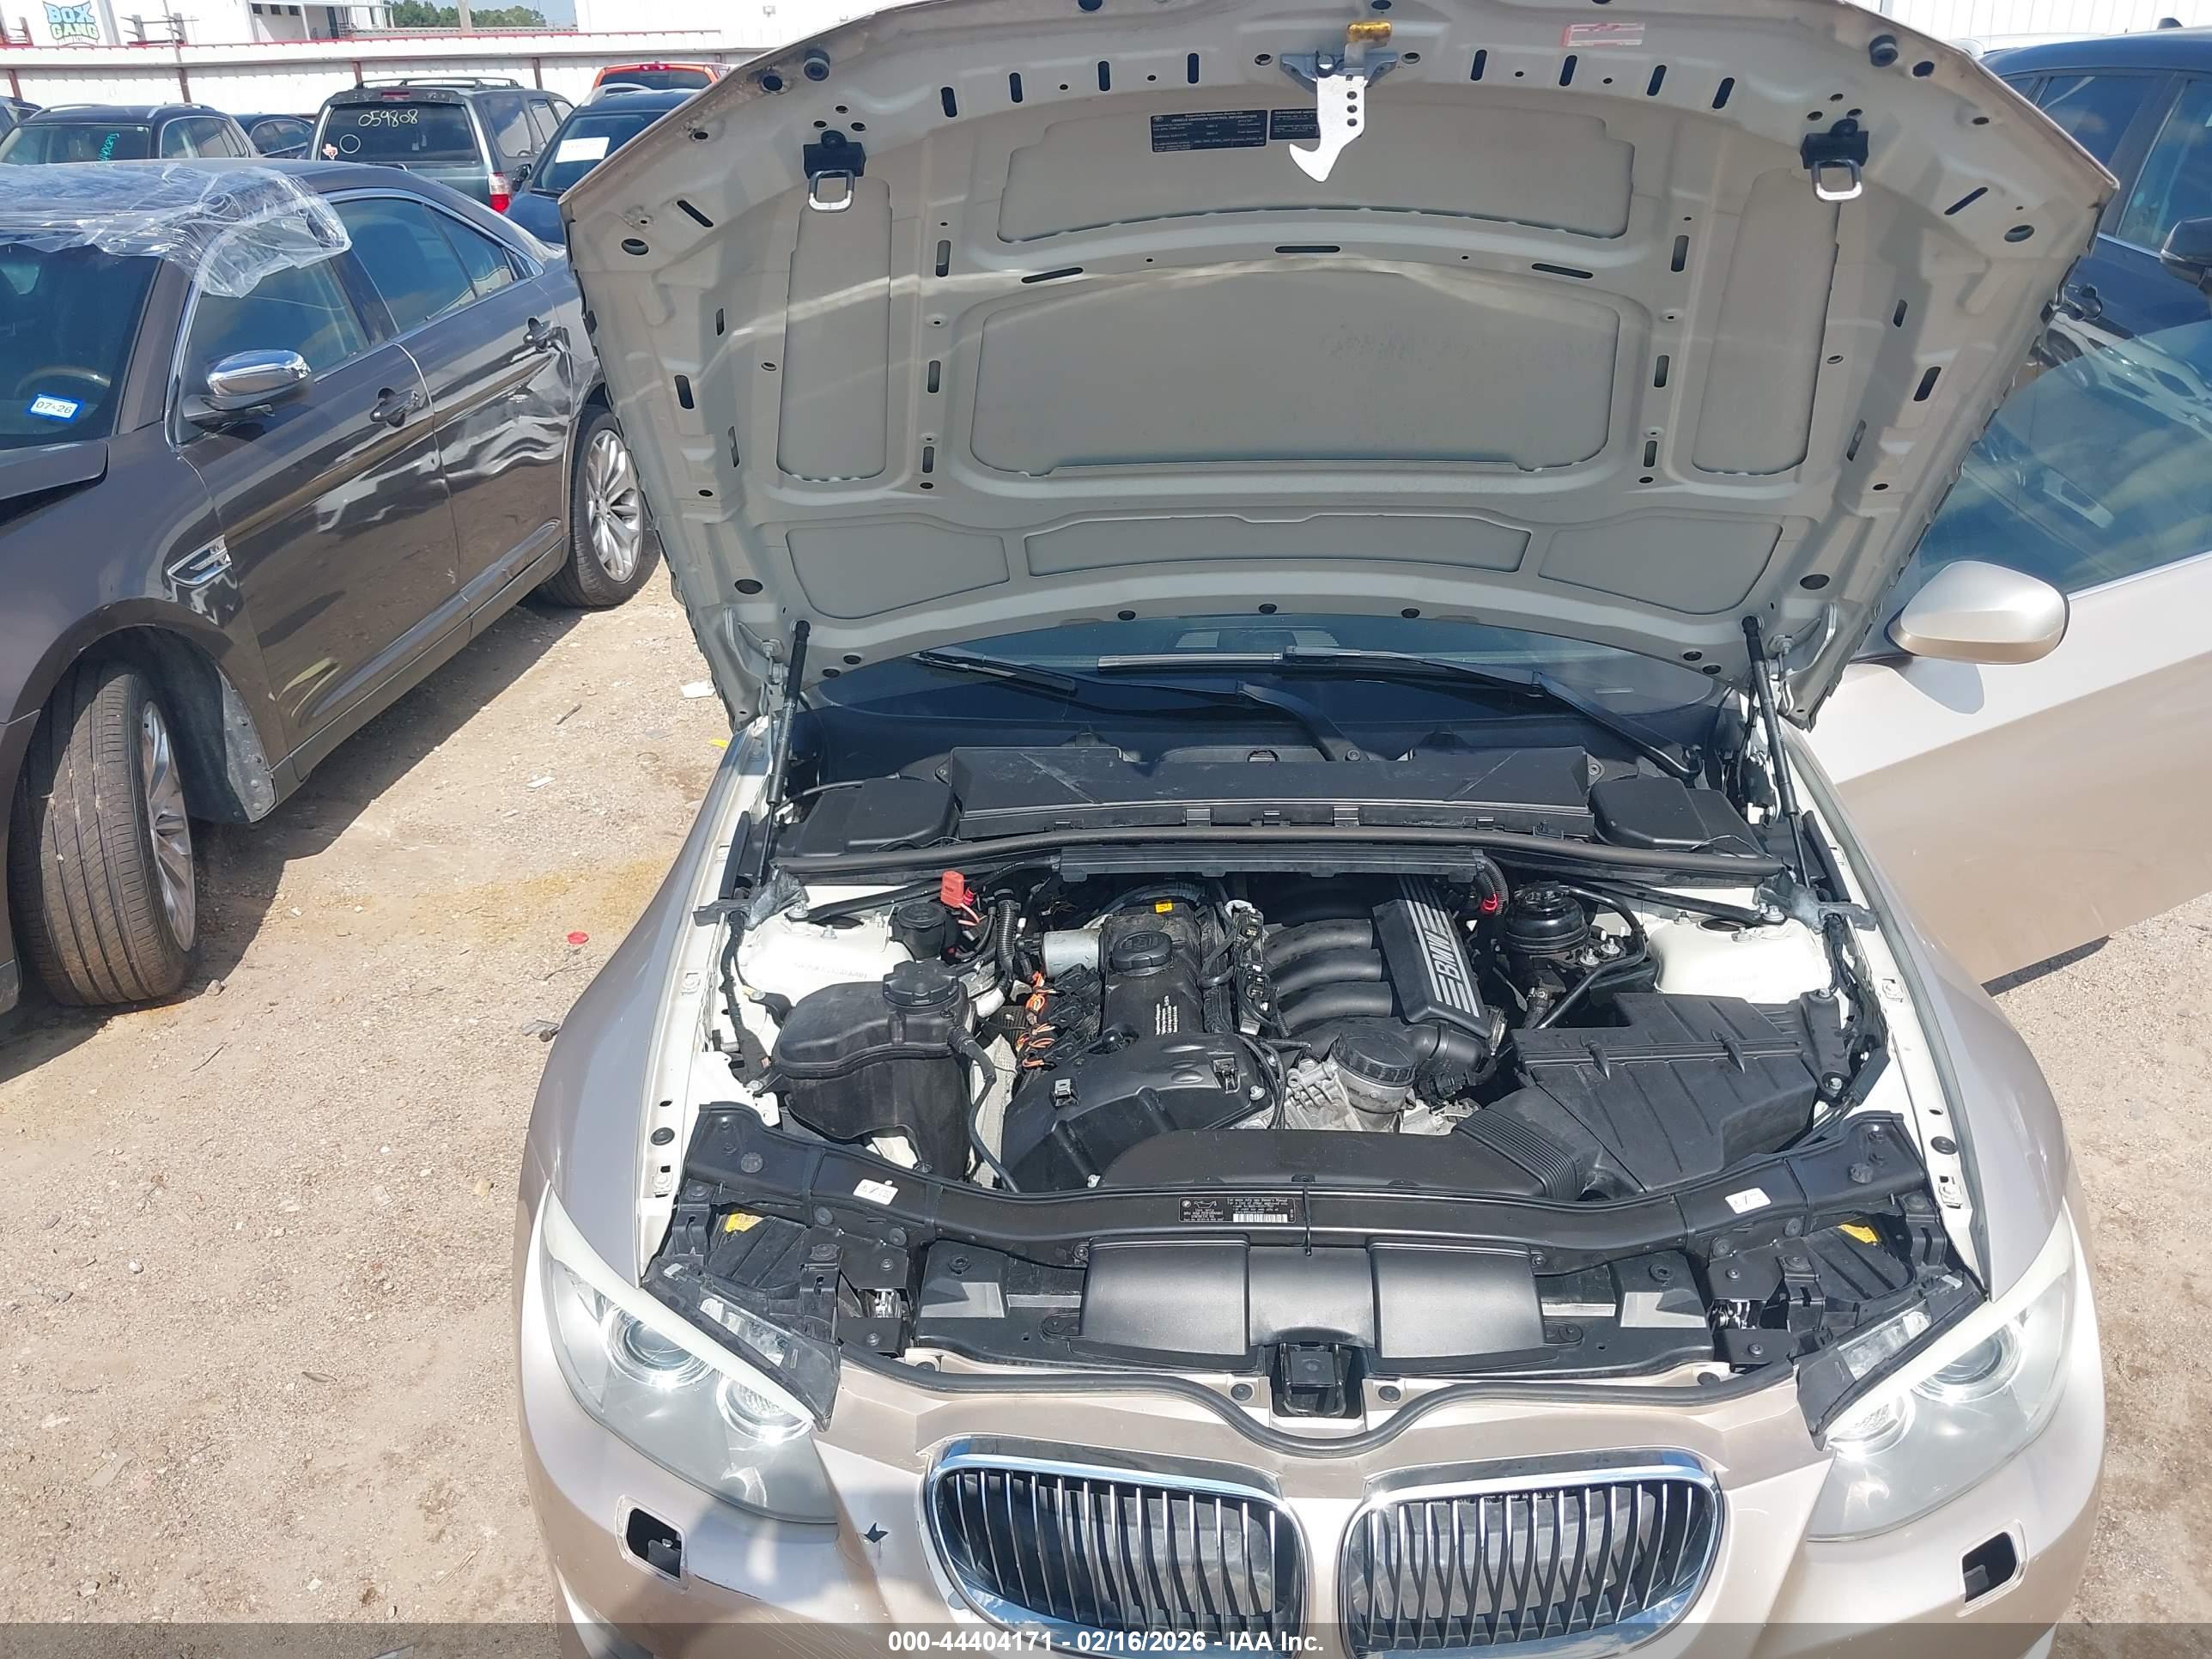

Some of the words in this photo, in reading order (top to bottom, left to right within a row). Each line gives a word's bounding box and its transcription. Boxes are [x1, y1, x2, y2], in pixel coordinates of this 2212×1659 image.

[42, 1, 96, 24] BOX
[50, 22, 100, 40] GANG
[358, 108, 418, 127] 059808
[1425, 929, 1462, 981] BMW
